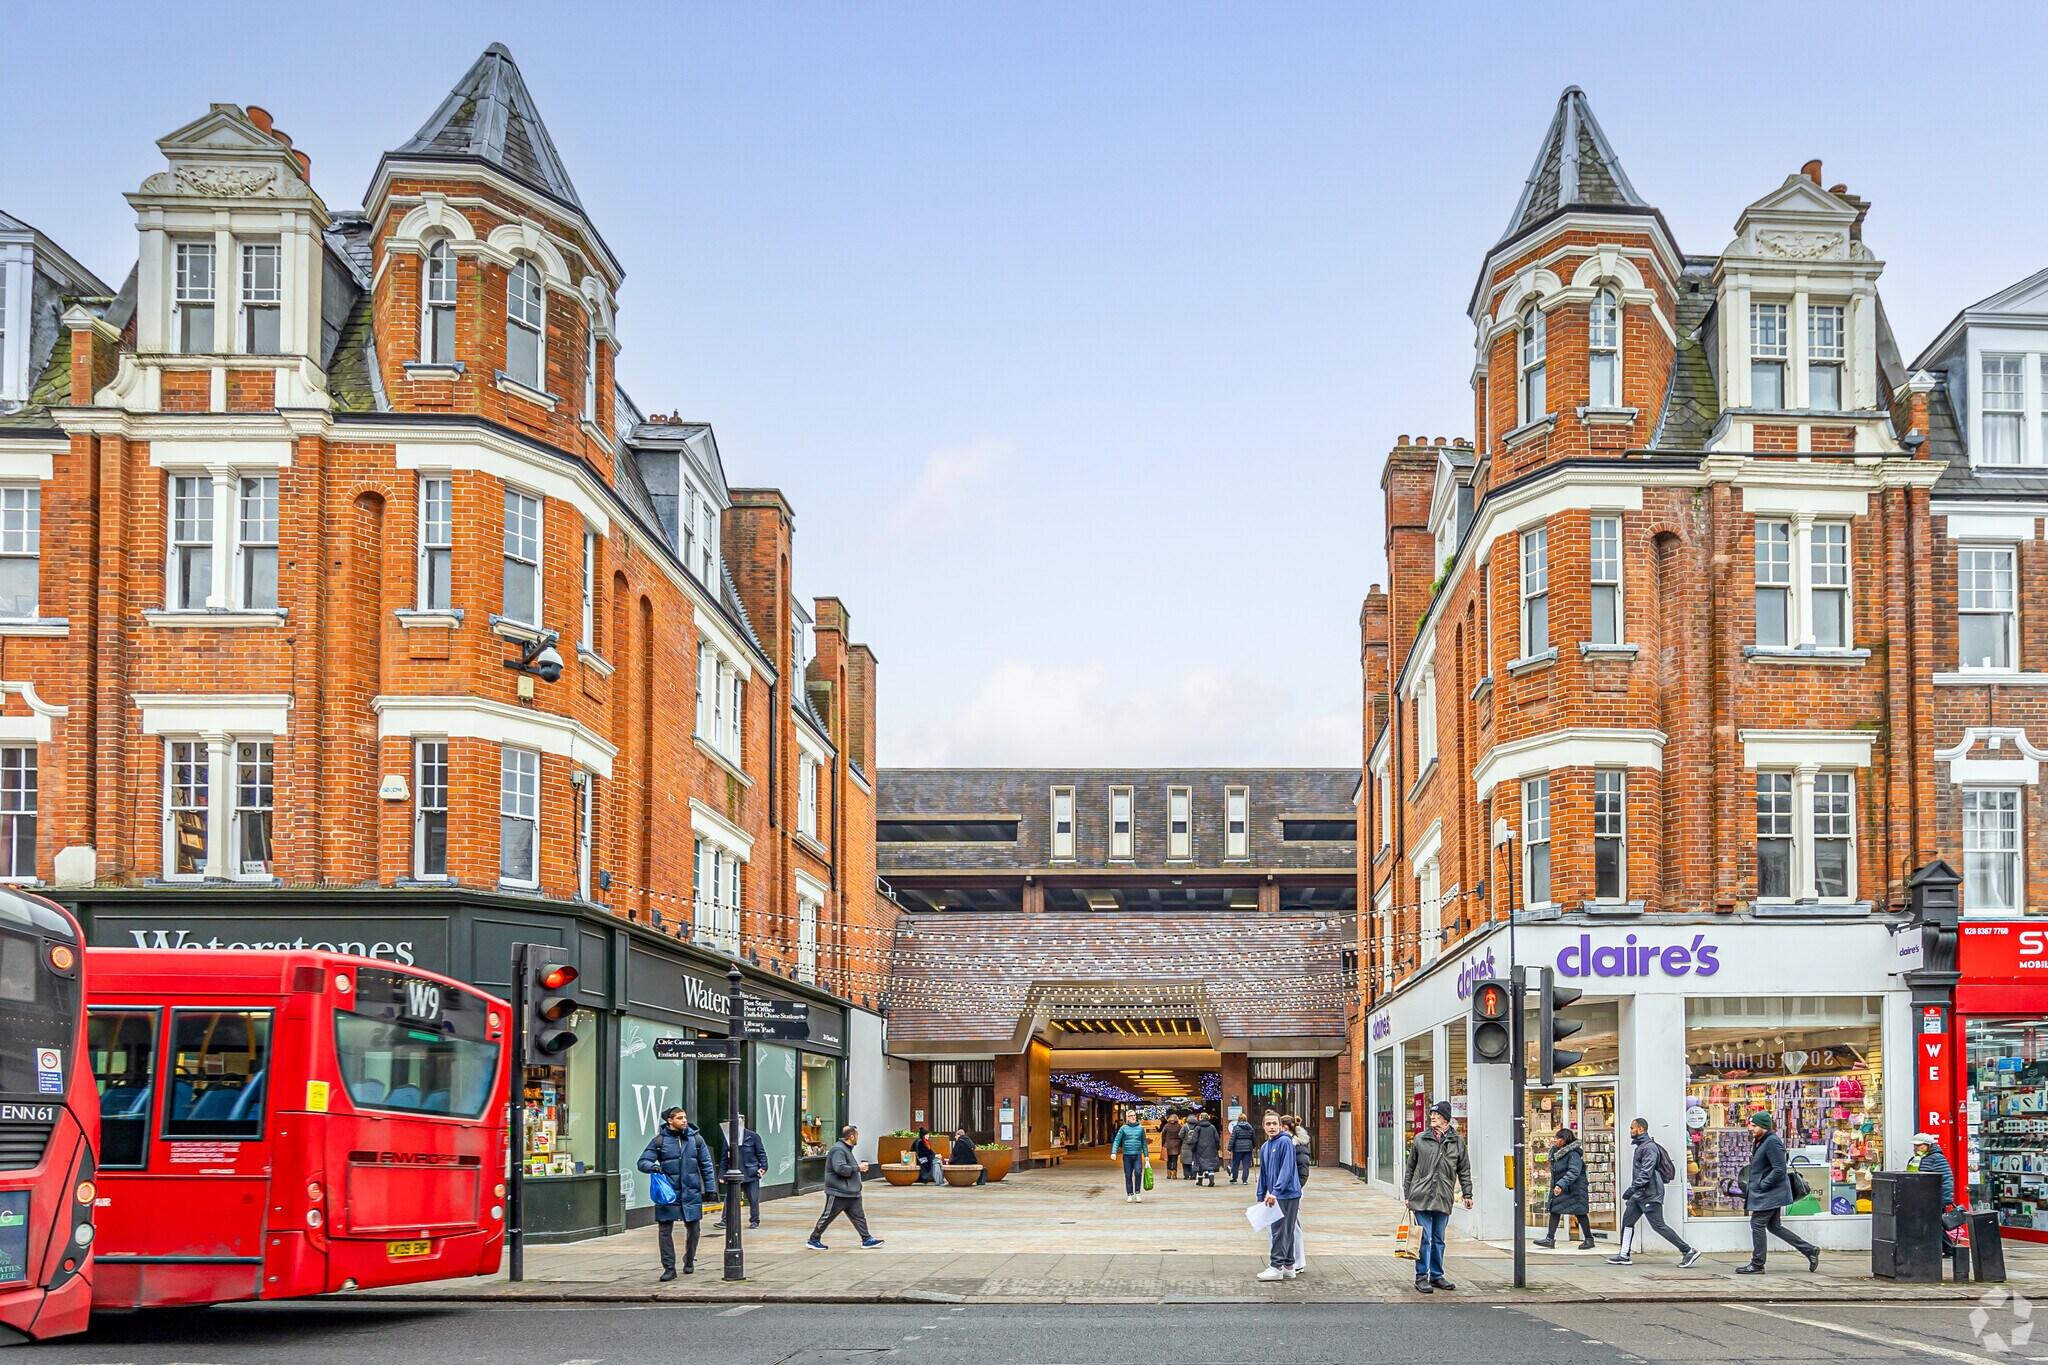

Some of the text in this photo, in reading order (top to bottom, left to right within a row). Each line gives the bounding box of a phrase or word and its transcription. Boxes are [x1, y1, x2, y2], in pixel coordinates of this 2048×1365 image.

[1556, 933, 1720, 977] claire's
[1899, 945, 1920, 956] claire's
[2019, 931, 2048, 954] S
[408, 982, 440, 1020] W9
[1372, 1009, 1391, 1041] claire's
[632, 1084, 668, 1136] W
[764, 1094, 786, 1134] W
